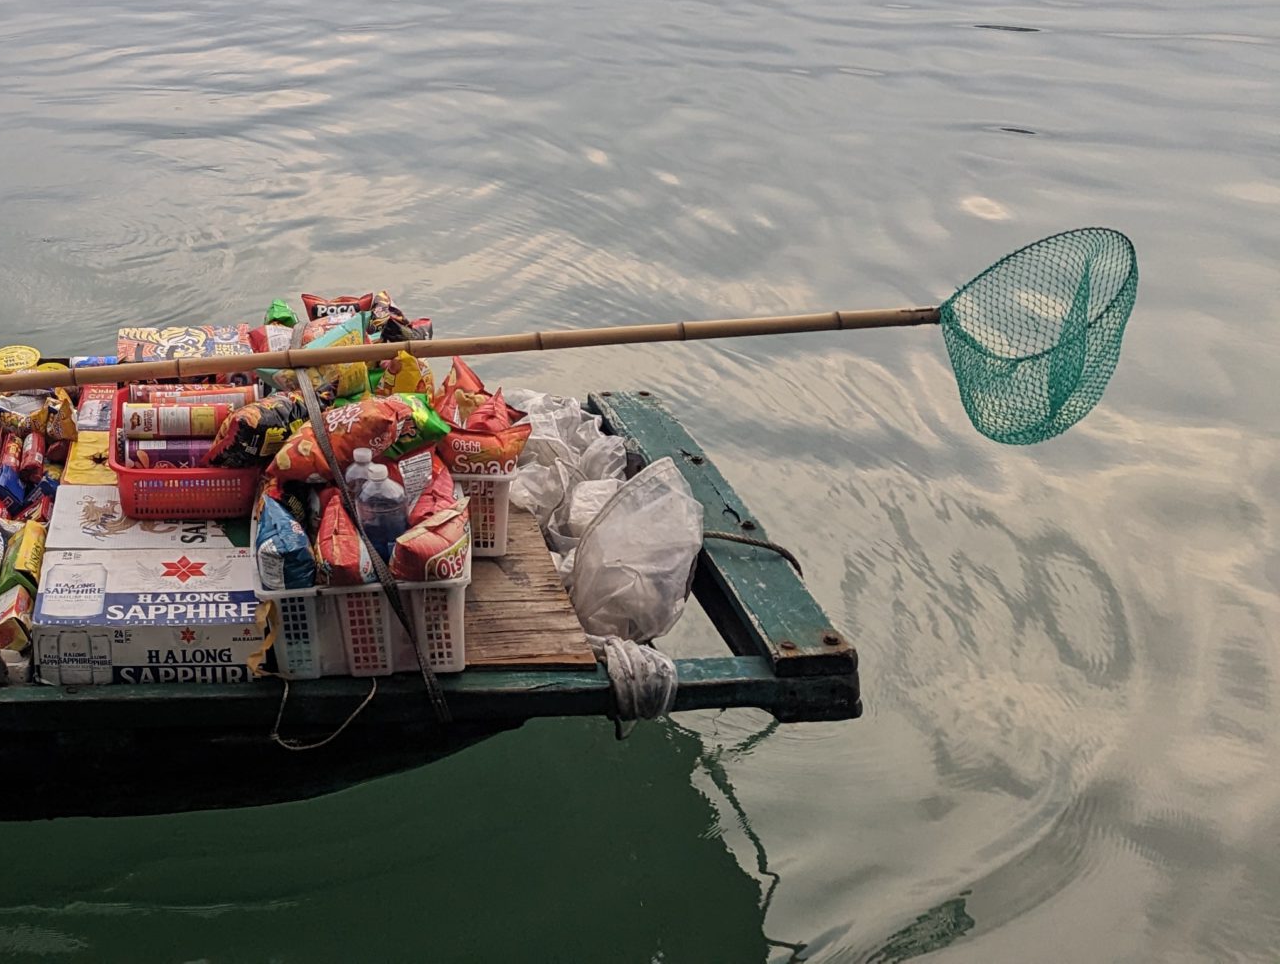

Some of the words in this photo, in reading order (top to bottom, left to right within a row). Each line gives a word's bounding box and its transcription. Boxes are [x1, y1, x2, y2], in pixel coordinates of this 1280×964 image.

[316, 305, 356, 318] POCA
[452, 439, 480, 453] Oishi
[452, 454, 518, 475] Snac
[137, 593, 230, 603] HALONG
[106, 602, 260, 620] SAPPHIRE
[147, 648, 232, 664] HALONG
